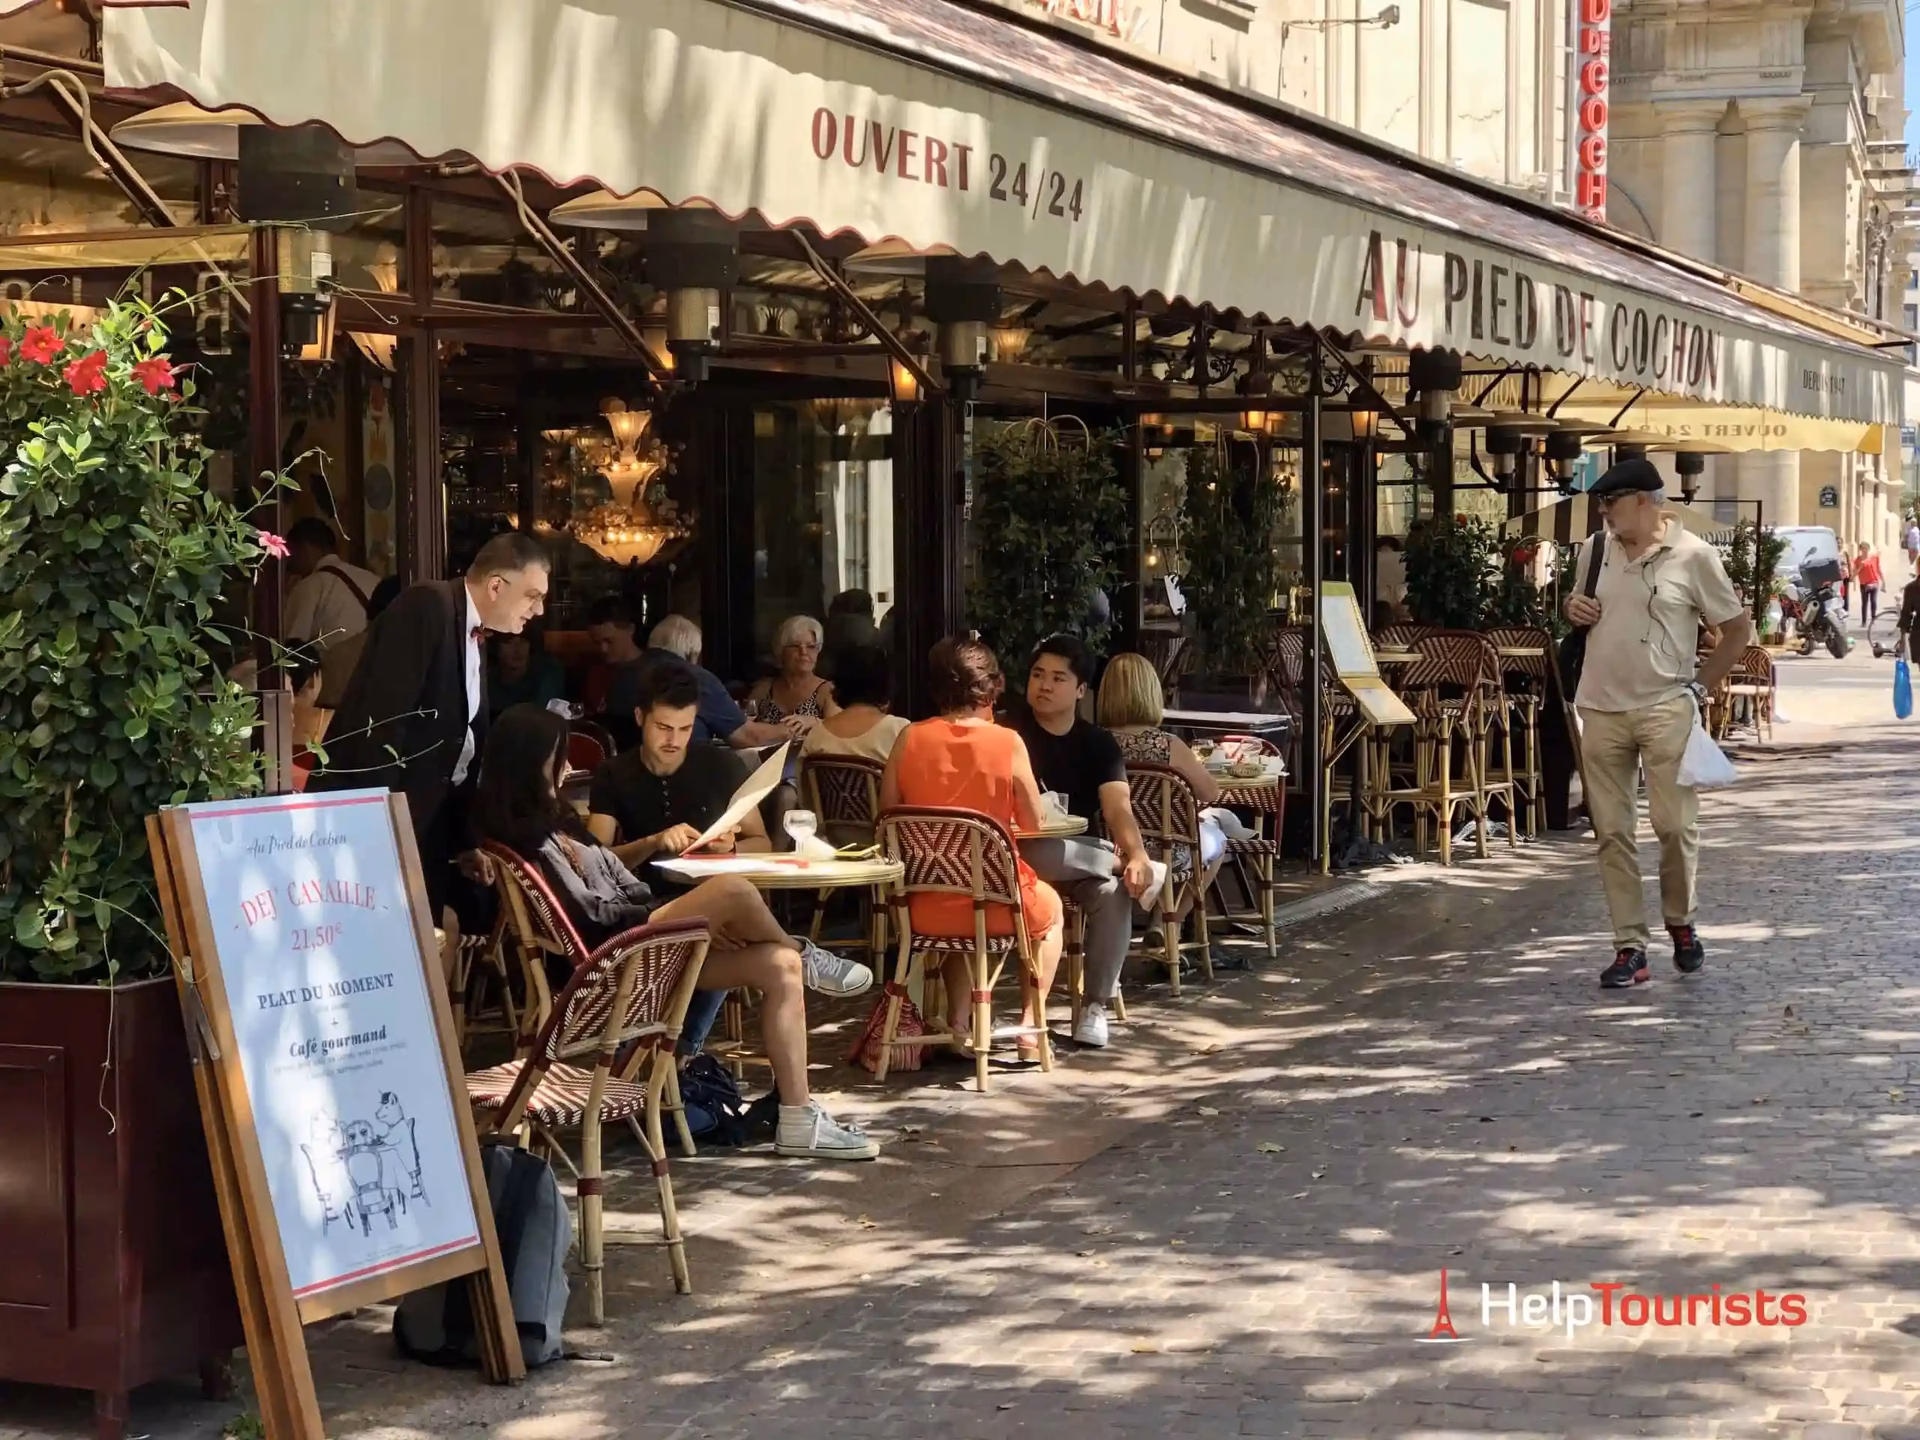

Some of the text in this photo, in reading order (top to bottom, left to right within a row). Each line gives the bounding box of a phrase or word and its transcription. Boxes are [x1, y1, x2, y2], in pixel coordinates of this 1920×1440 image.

[811, 107, 1083, 222] OUVERT 24/24
[1355, 230, 1720, 390] AU PIED DE COCHON
[246, 838, 264, 858] Au
[268, 833, 294, 855] Pied
[295, 834, 306, 850] de
[287, 879, 376, 910] CANAILLE
[257, 987, 297, 1010] PLAT
[301, 984, 323, 1003] DU
[328, 973, 394, 997] MOMENT
[289, 1037, 317, 1060] Café
[321, 1025, 387, 1056] gourmand
